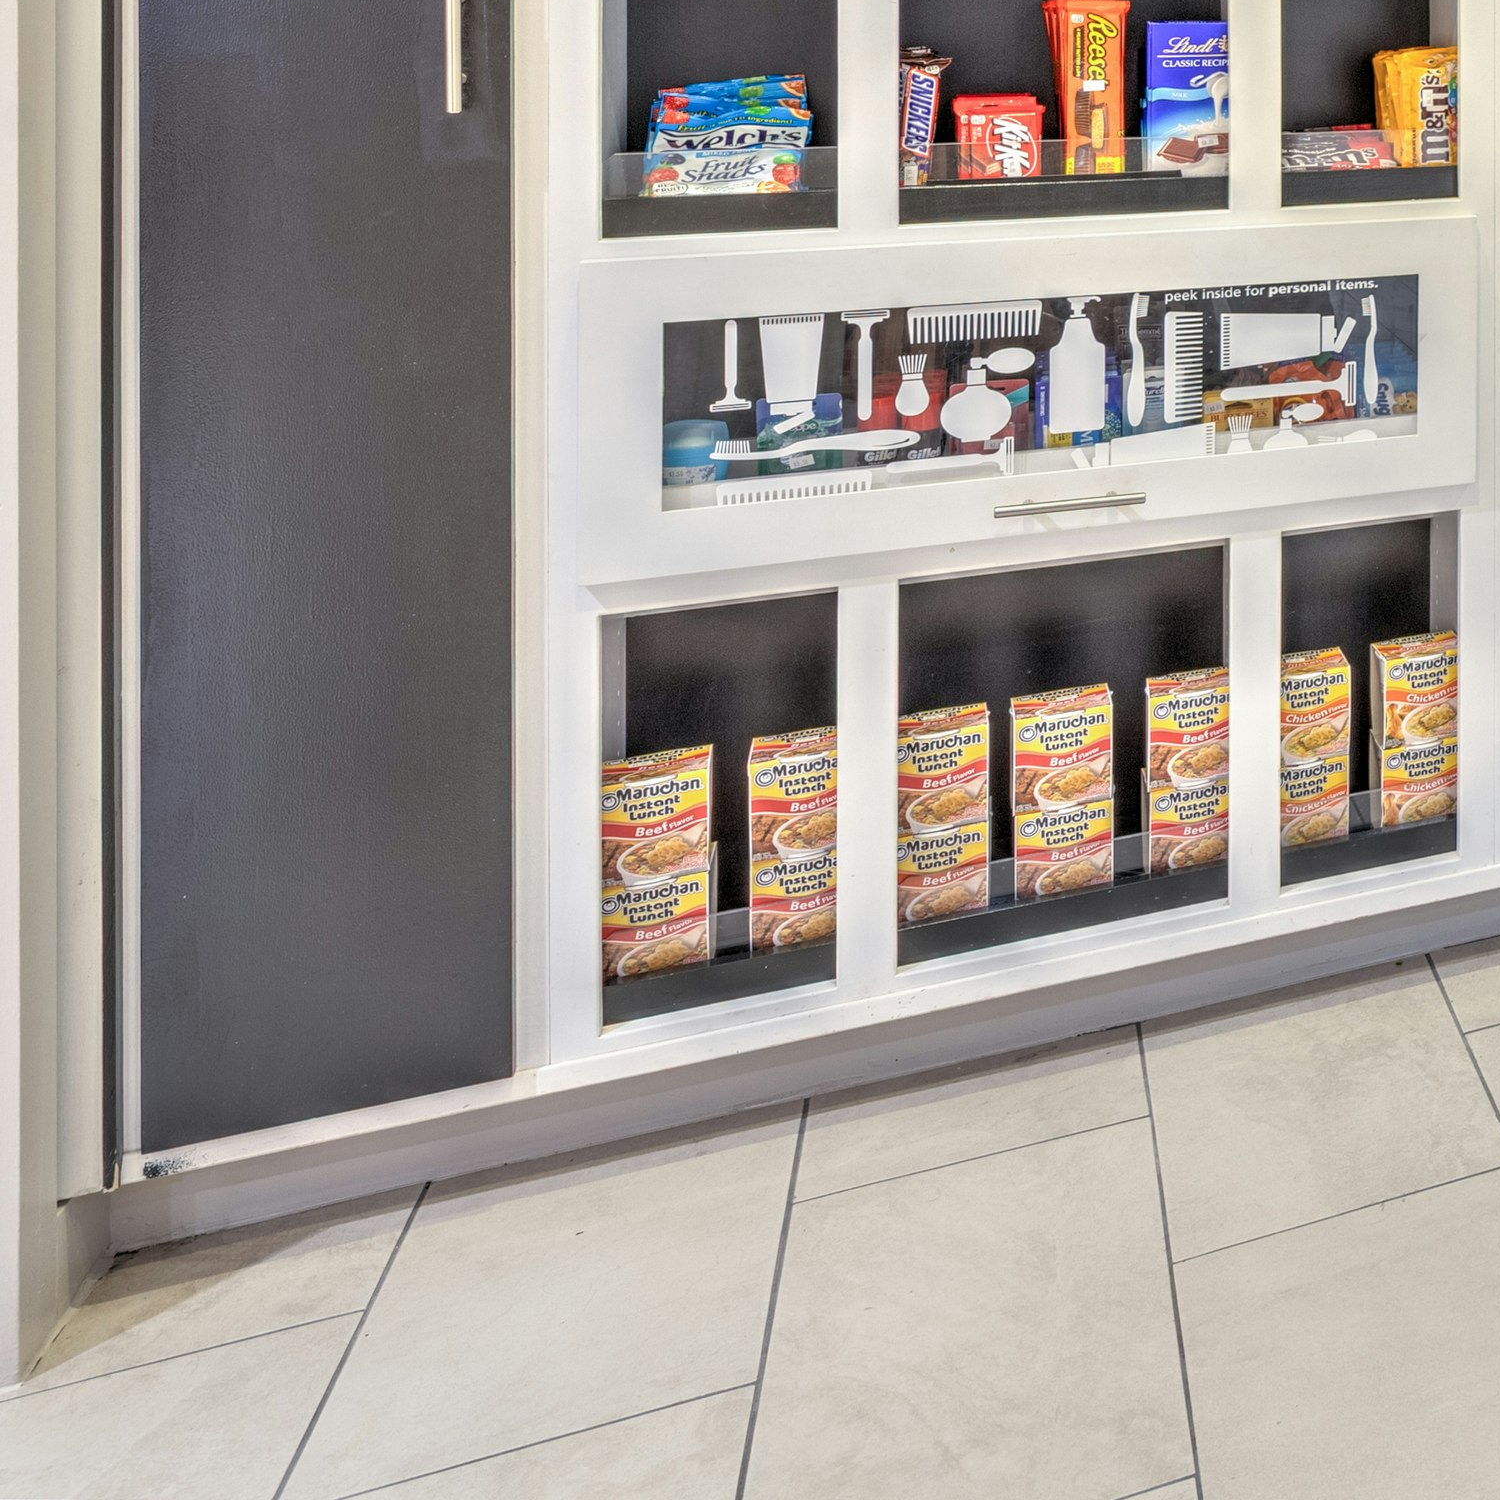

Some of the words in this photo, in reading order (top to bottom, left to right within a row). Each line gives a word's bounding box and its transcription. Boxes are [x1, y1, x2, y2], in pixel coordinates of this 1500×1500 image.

[1087, 13, 1118, 86] Reese'
[1162, 37, 1218, 54] Lindt
[1162, 60, 1200, 68] CLASSIC
[1202, 60, 1229, 68] RECIP
[904, 73, 935, 156] SNICKERS
[663, 129, 802, 149] Welch's
[681, 162, 767, 182] Snacks
[702, 154, 759, 173] Fruit
[1164, 290, 1198, 305] peek
[1201, 286, 1242, 300] inside
[1244, 284, 1266, 298] for
[1268, 281, 1332, 299] personal
[1335, 278, 1379, 291] items.
[1282, 673, 1344, 691] Maruchan
[1286, 687, 1329, 701] Instant
[1291, 697, 1324, 709] Lunch
[1286, 708, 1328, 723] Chicken
[1328, 703, 1347, 714] Flavor
[616, 778, 702, 801] Maruchan
[623, 795, 680, 813] Instant
[629, 806, 674, 821] Lunch
[635, 823, 668, 838] Beef
[669, 815, 694, 830] Flavor
